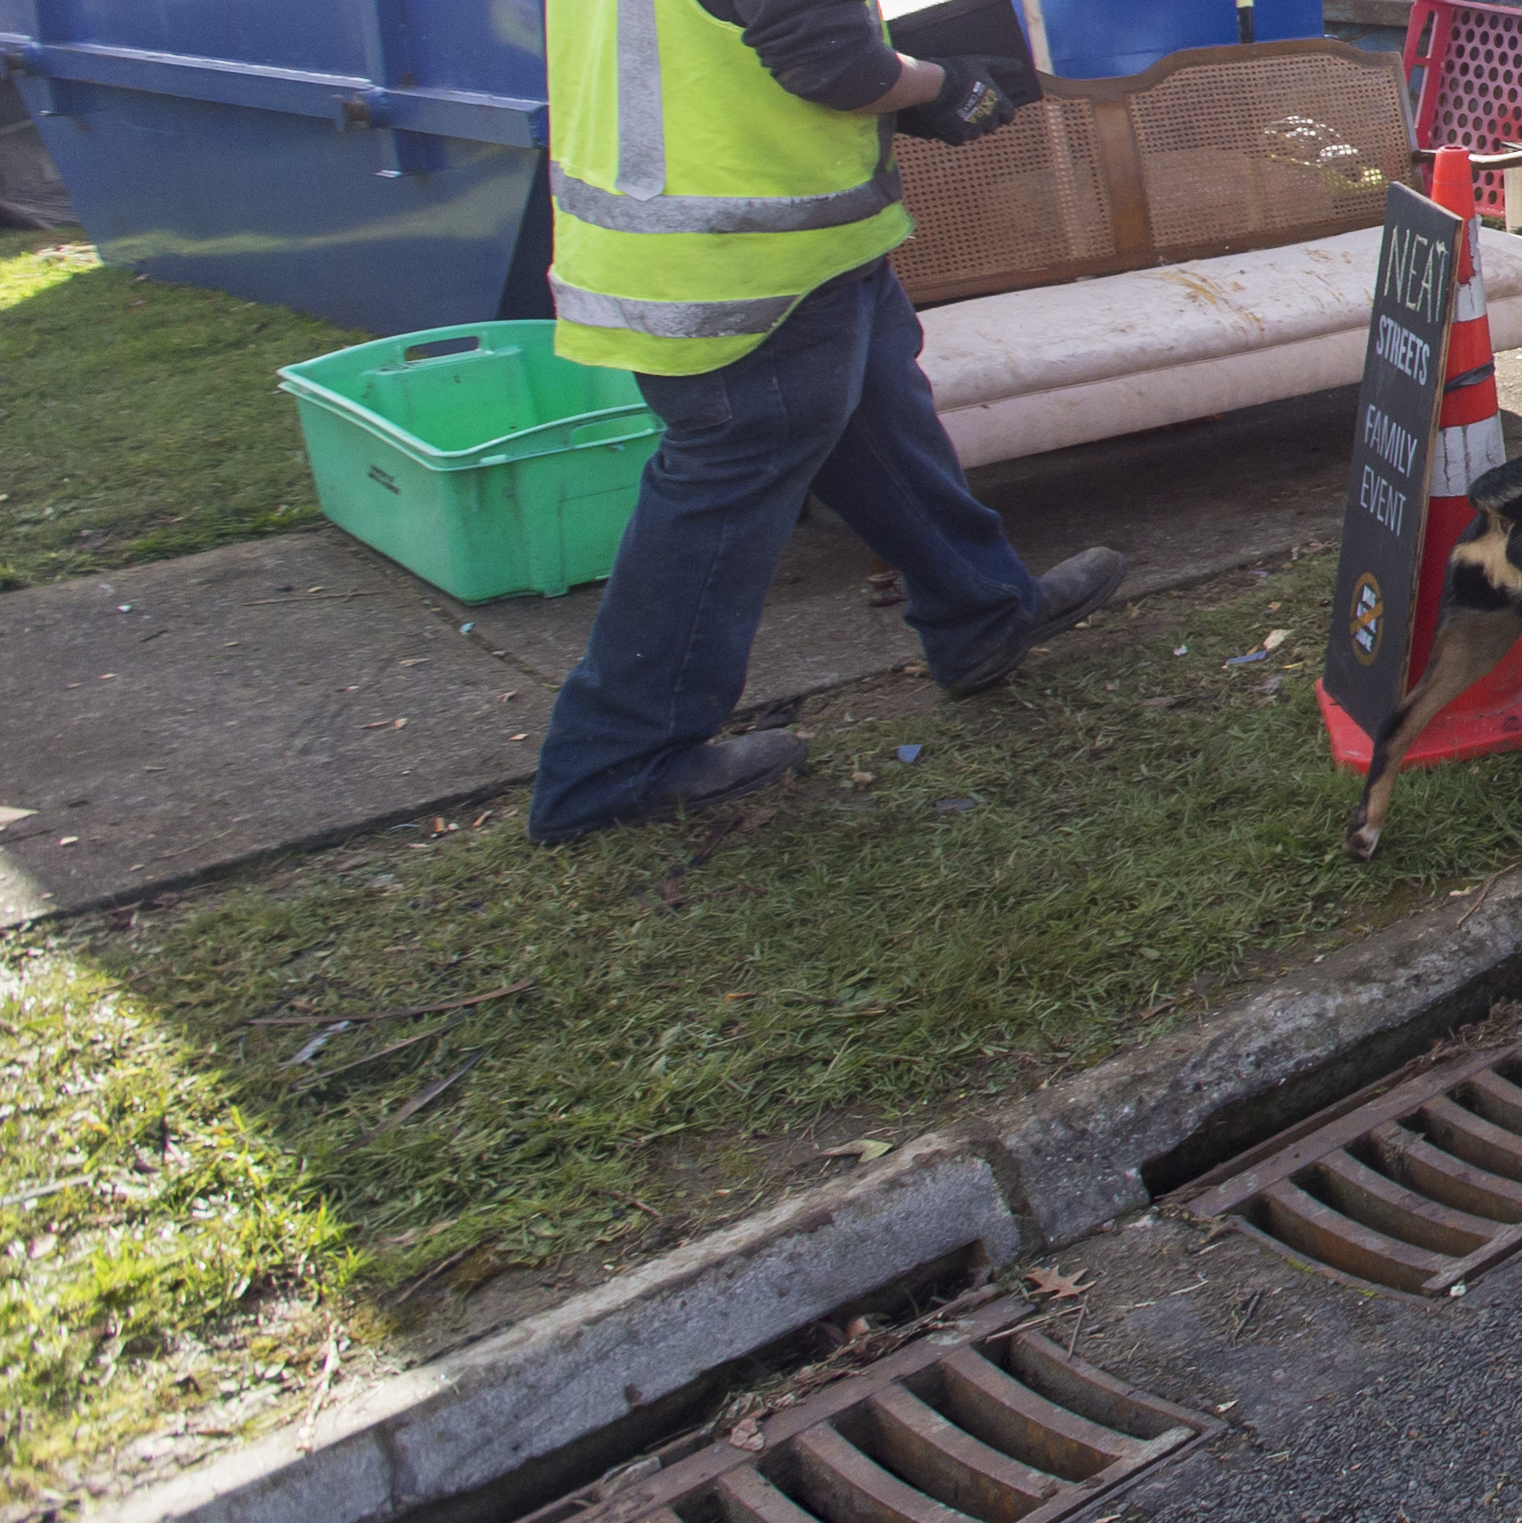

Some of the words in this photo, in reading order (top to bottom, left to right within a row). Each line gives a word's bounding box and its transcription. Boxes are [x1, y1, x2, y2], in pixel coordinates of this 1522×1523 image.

[1383, 224, 1449, 324] NEAT
[1376, 314, 1431, 386] STREETS
[1364, 403, 1418, 478] FAMILY
[1360, 464, 1407, 537] EVENT
